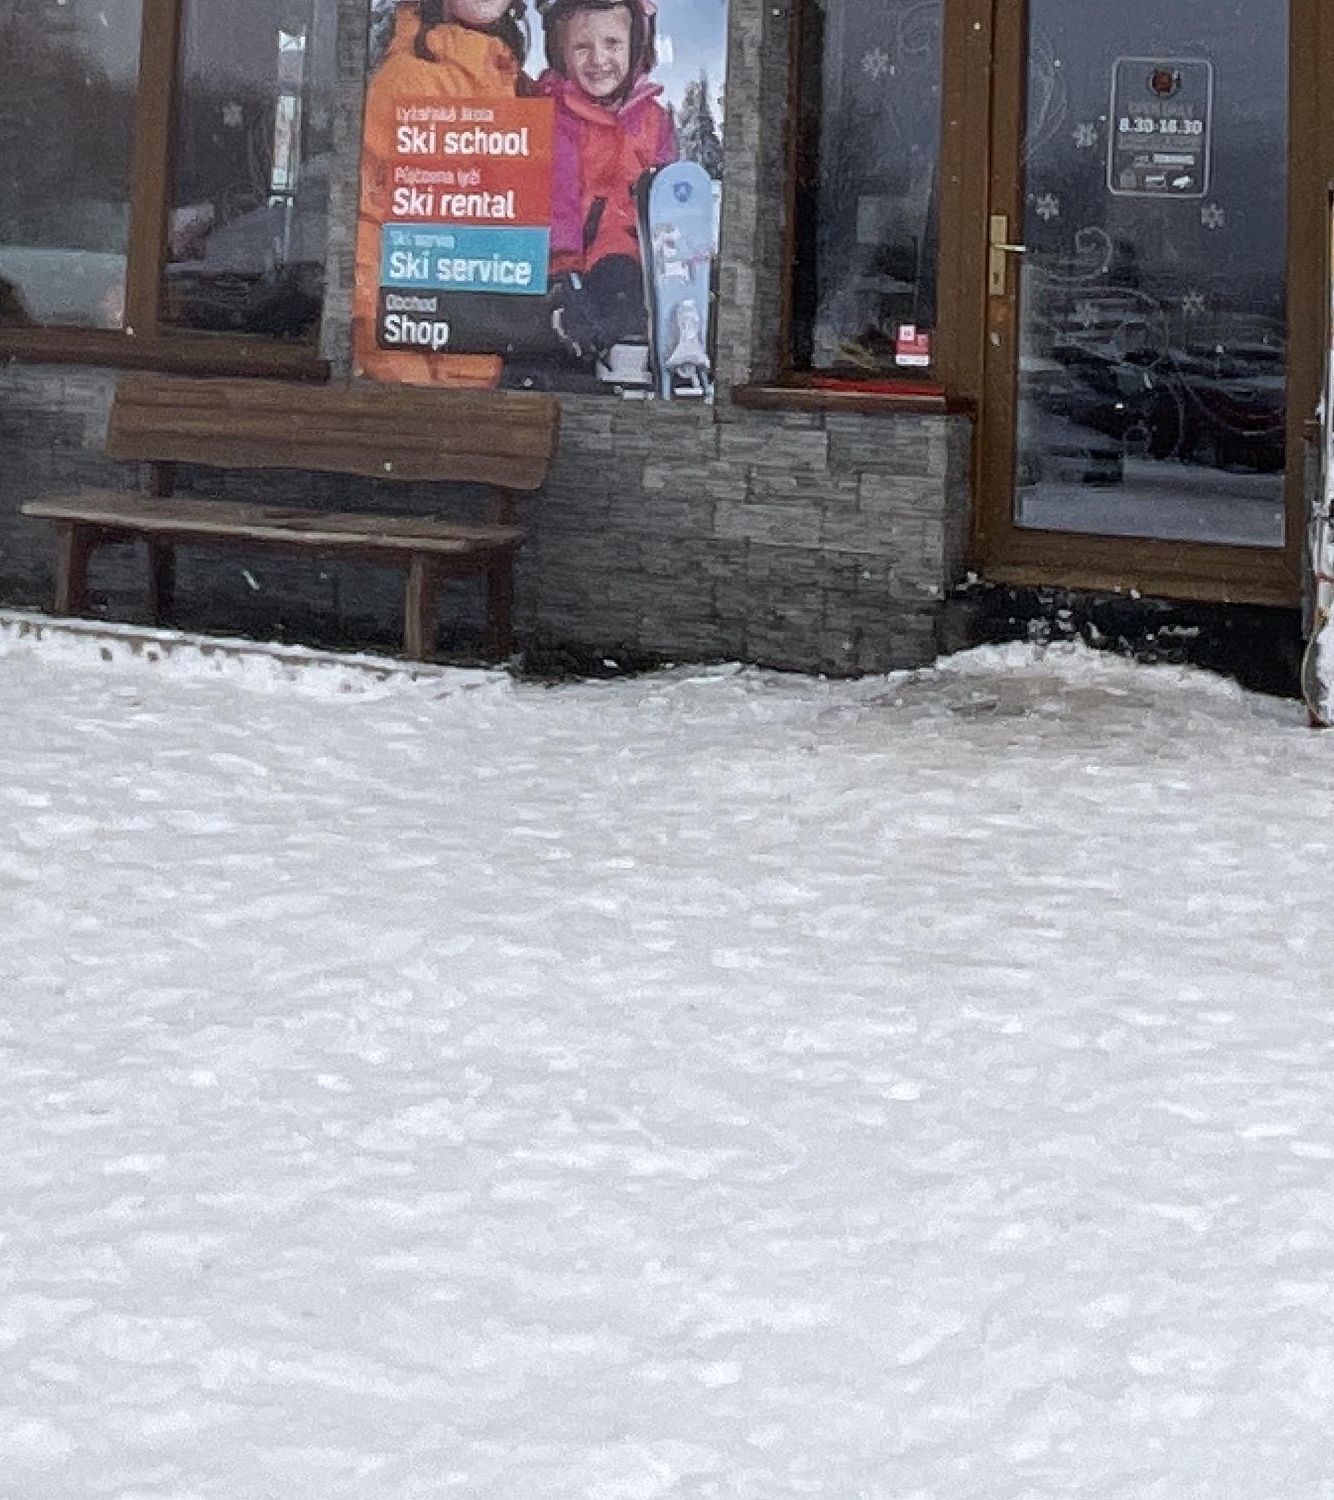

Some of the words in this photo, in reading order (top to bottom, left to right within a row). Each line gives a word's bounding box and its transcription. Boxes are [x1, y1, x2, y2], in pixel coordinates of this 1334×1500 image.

[396, 125, 437, 155] Ski
[443, 126, 529, 157] school
[392, 186, 434, 217] Ski
[440, 189, 516, 219] rental
[388, 250, 431, 280] Ski
[435, 252, 533, 286] service
[383, 313, 450, 351] Shop
